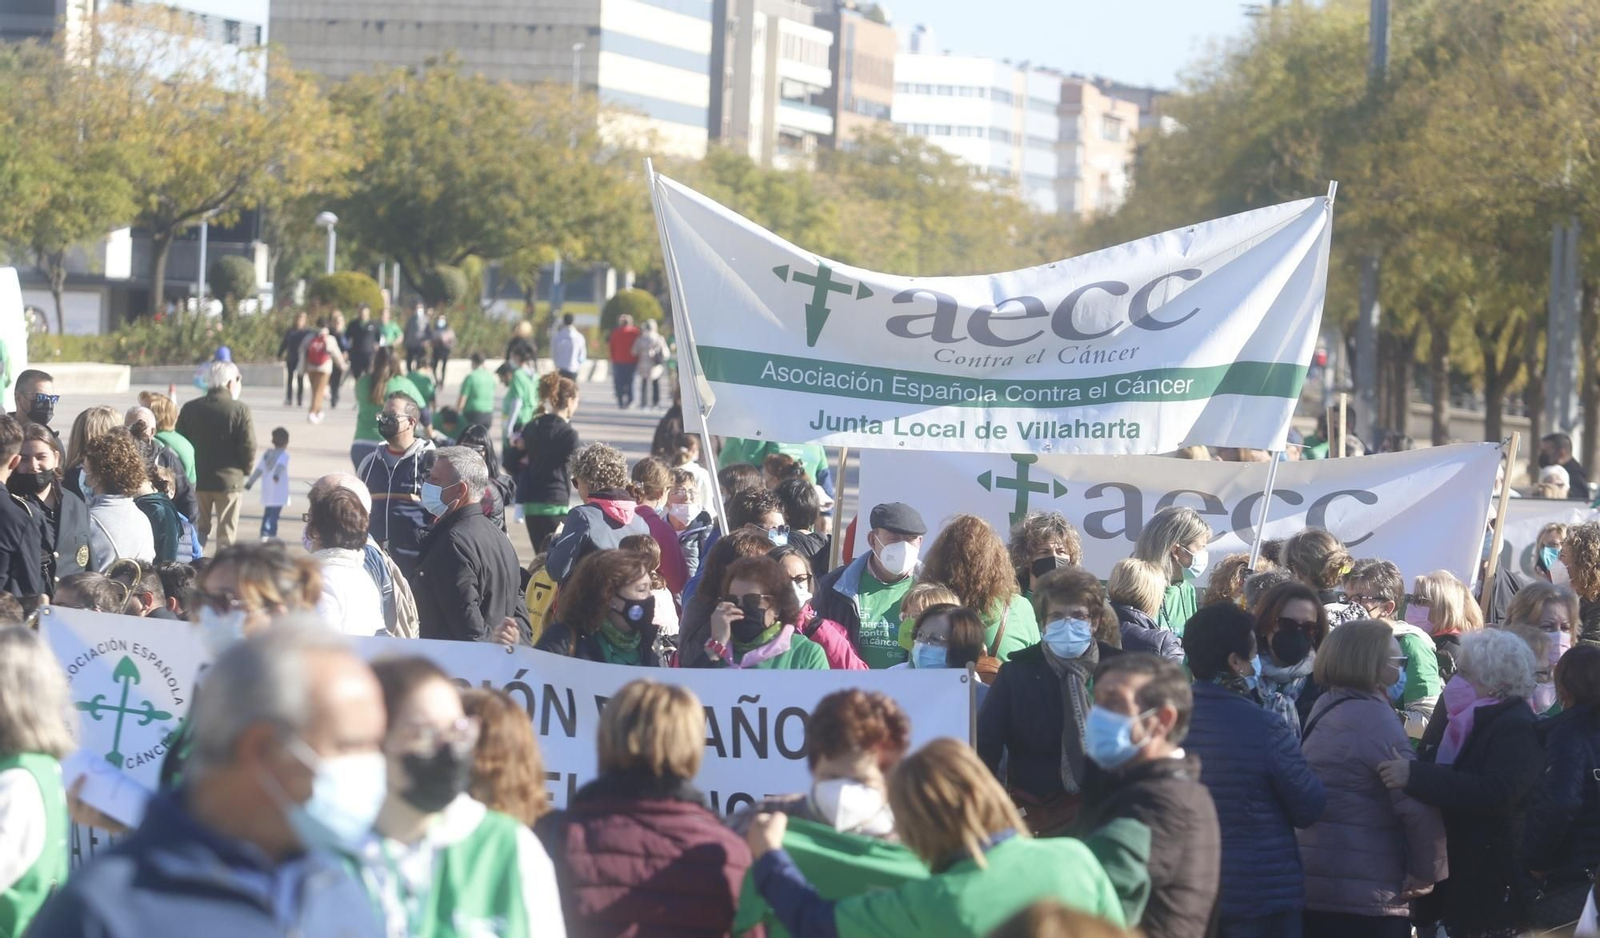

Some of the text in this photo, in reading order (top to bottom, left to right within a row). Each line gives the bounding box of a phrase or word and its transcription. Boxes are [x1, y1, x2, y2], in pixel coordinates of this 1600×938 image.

[886, 268, 1202, 347] aecc
[933, 344, 1140, 368] Contra el Cáncer
[760, 360, 1195, 402] Asociación Española Contra el Cáncer
[809, 409, 1141, 441] Junta Local de Villaharta
[1083, 481, 1379, 548] aecc
[859, 629, 890, 638] contra
[860, 619, 894, 629] marcha
[869, 636, 901, 647] cánce
[132, 642, 184, 706] ESPAÑOLA
